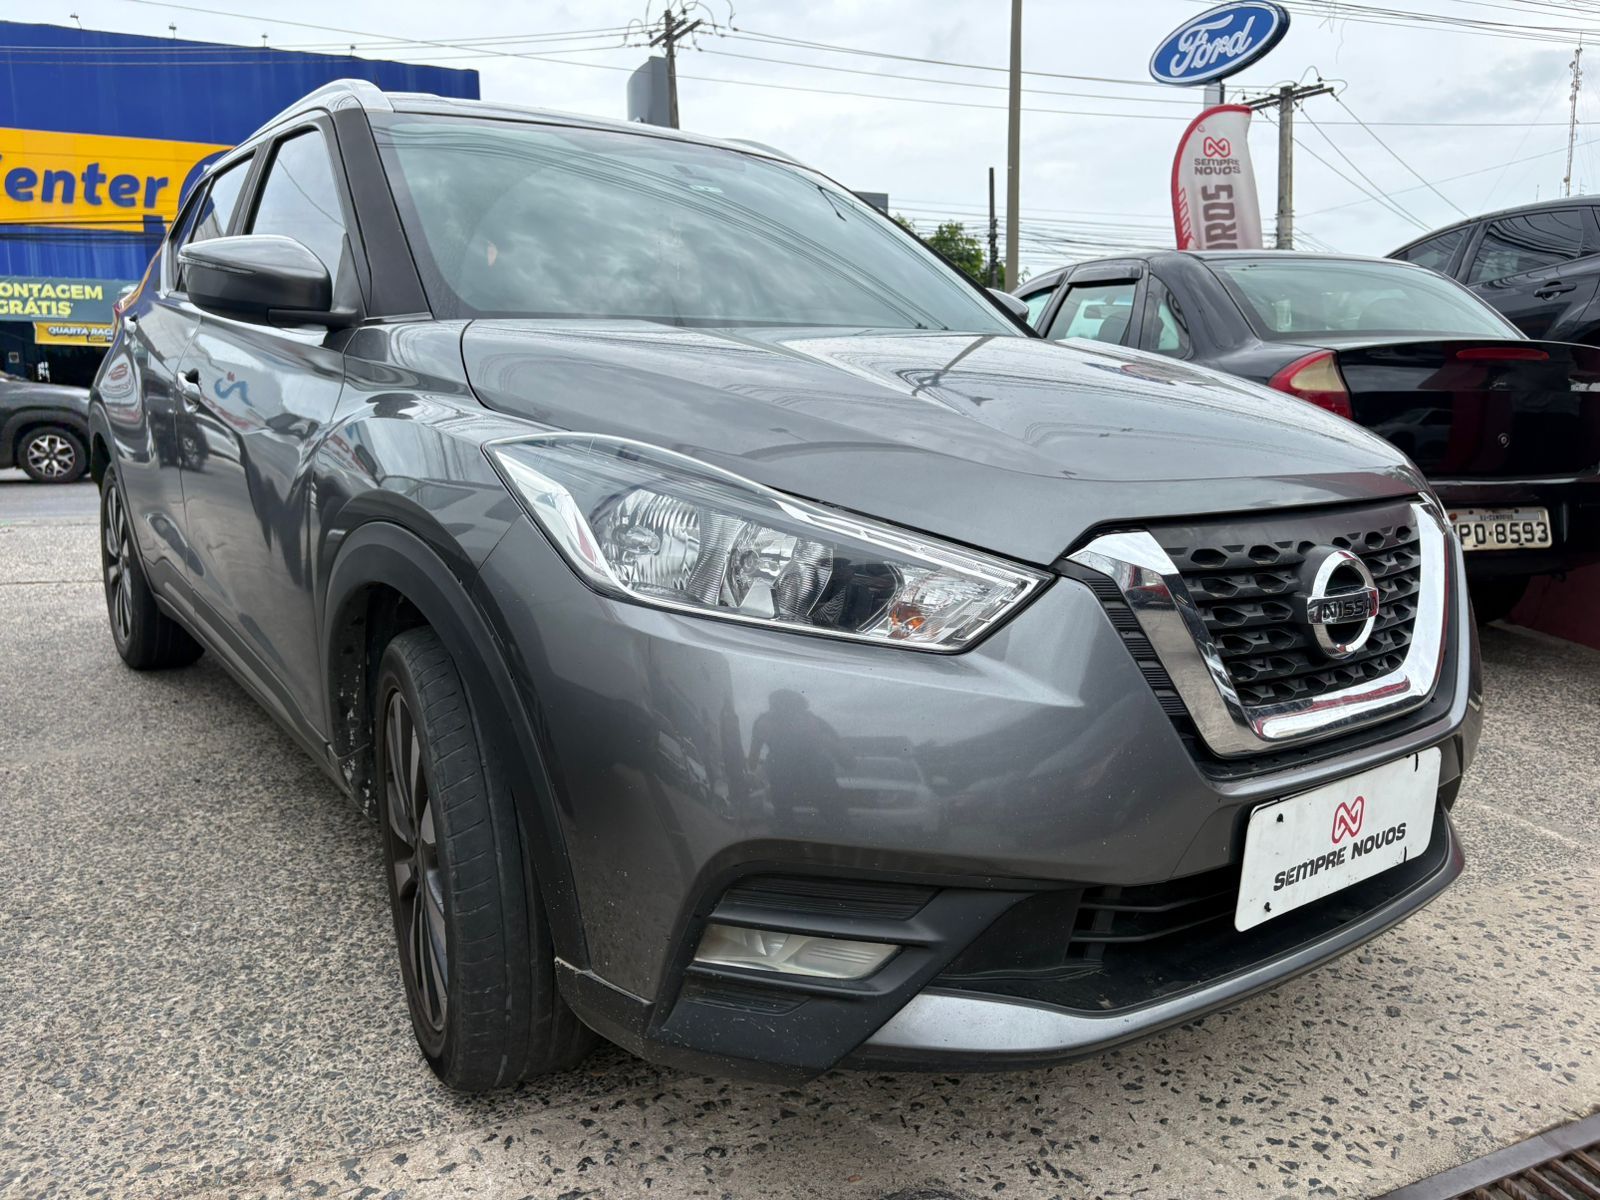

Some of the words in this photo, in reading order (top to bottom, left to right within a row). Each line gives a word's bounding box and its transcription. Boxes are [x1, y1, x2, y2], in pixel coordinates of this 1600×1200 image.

[1169, 14, 1256, 77] Ford
[0, 154, 169, 209] enter
[1194, 158, 1239, 167] SEMPRE
[91, 328, 113, 337] RAC
[1273, 846, 1347, 892] SEMPRE
